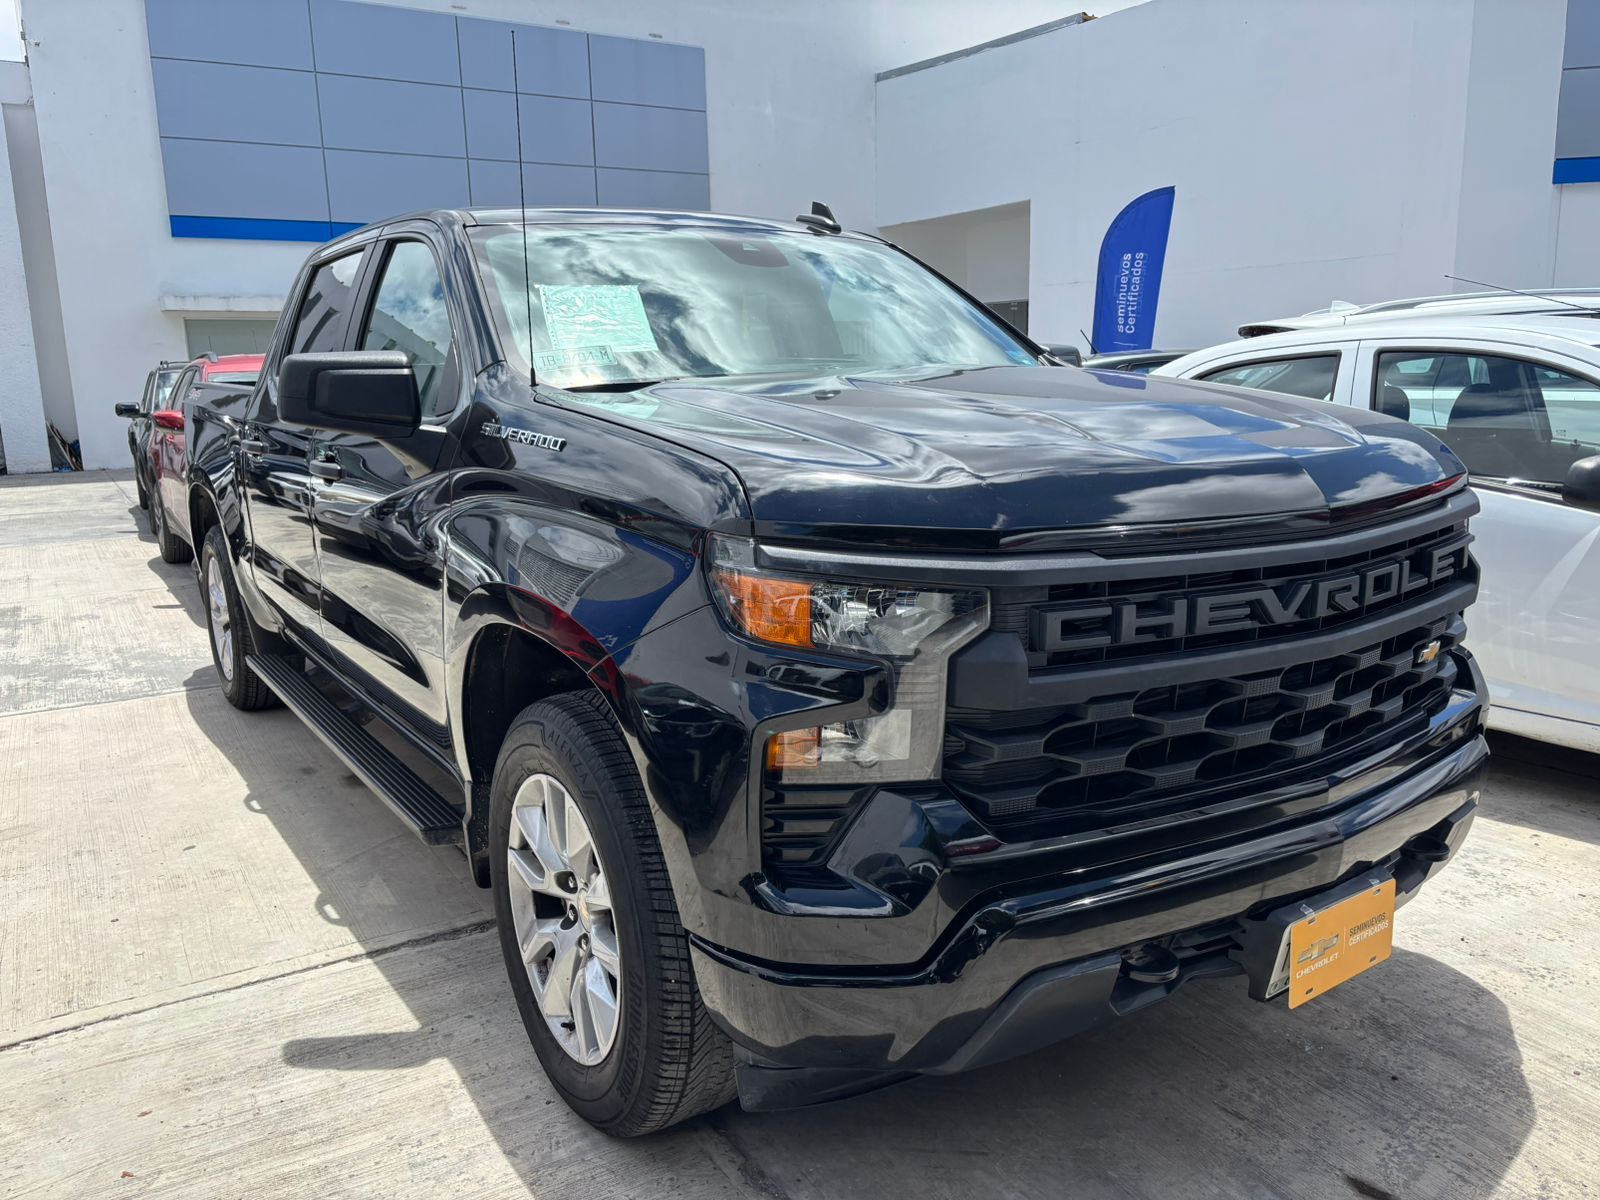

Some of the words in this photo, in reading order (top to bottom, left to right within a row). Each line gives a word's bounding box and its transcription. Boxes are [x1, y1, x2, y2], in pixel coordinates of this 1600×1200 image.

[1116, 253, 1132, 333] seminuevos
[1125, 252, 1144, 334] Certificados
[480, 421, 567, 452] SILVERADO
[1043, 535, 1475, 652] CHEVROLET
[547, 730, 588, 785] ALENZA
[1349, 912, 1386, 937] SEMINUEVOS
[1349, 919, 1389, 946] CERTIFICADOS
[1296, 952, 1339, 979] CHEVROLET
